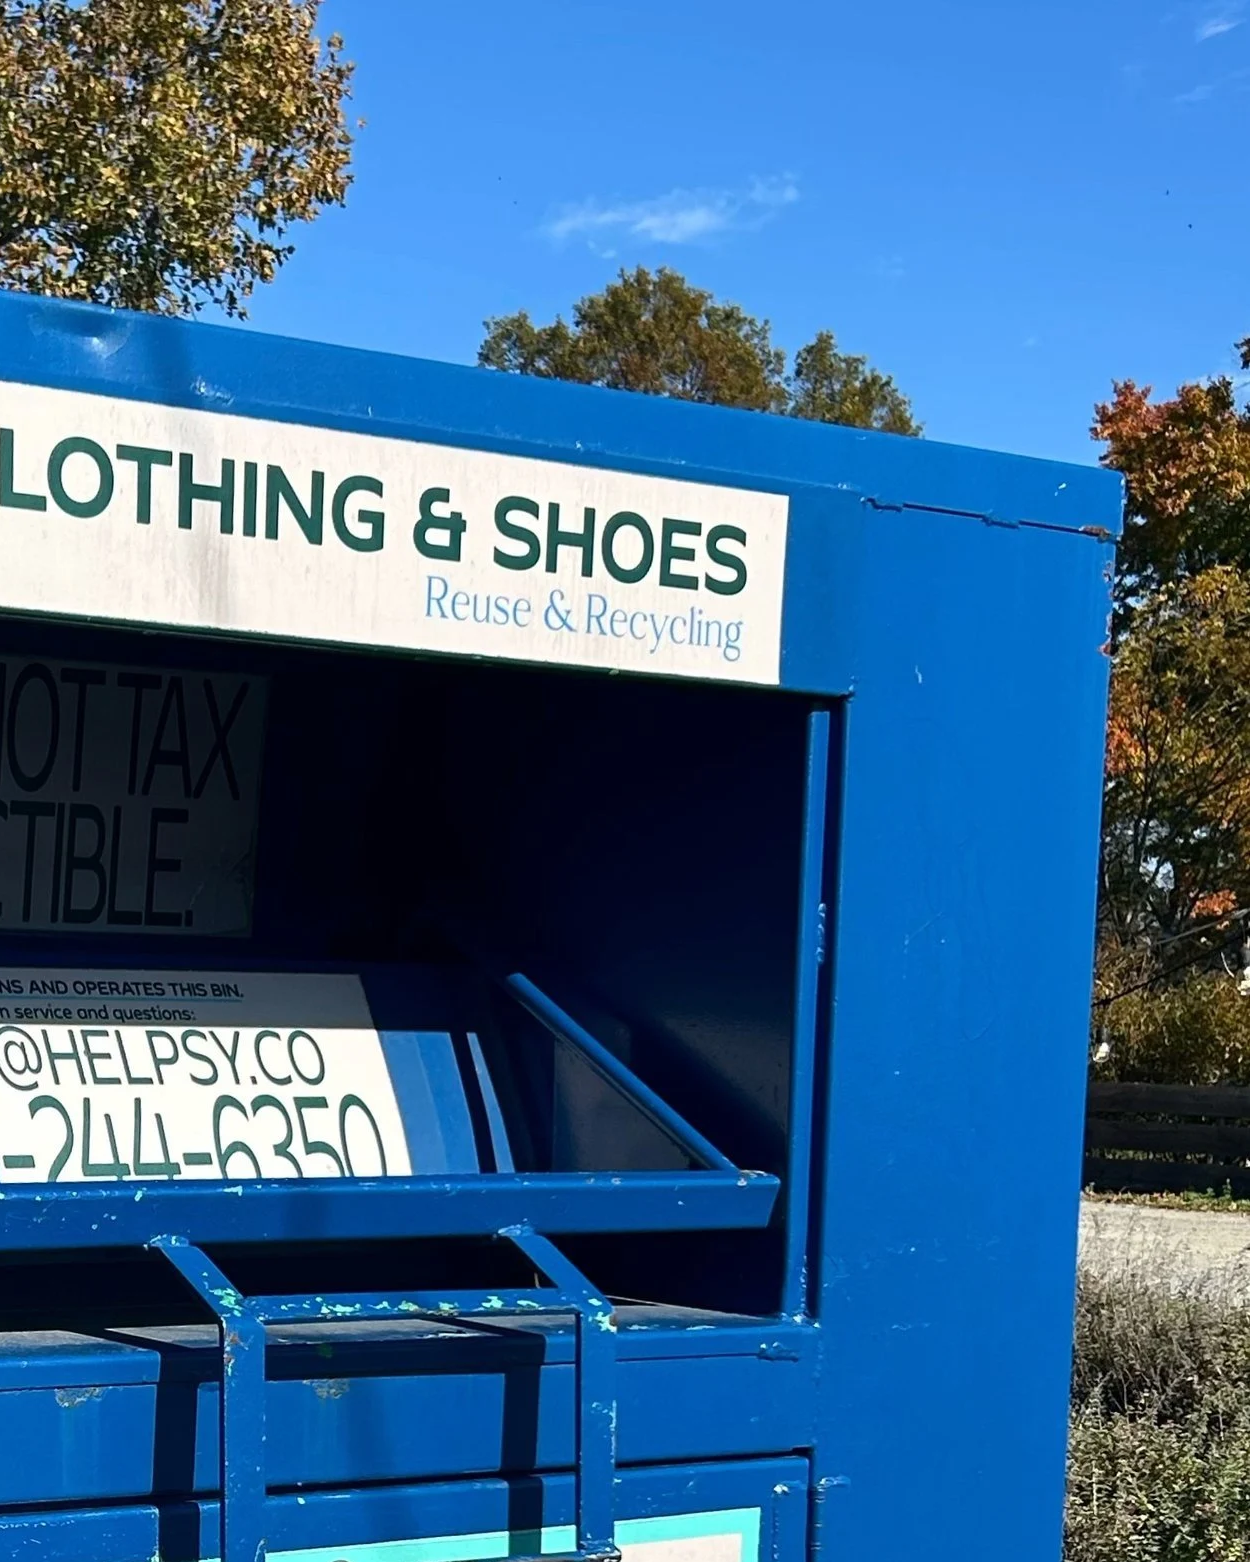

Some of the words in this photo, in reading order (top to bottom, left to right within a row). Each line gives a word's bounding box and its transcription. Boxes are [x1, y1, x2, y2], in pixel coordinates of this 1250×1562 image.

[412, 487, 466, 563] &
[493, 495, 748, 597] SHOES
[424, 574, 532, 628] Reuse
[544, 588, 577, 634] &
[586, 593, 744, 663] Recycling
[117, 671, 250, 802] TAX
[14, 1004, 73, 1021] service
[76, 1005, 110, 1021] and
[113, 1005, 197, 1024] questions:
[28, 979, 69, 996] AND
[72, 980, 166, 998] OPERATES
[167, 982, 208, 998] THIS
[211, 983, 245, 999] BIN.
